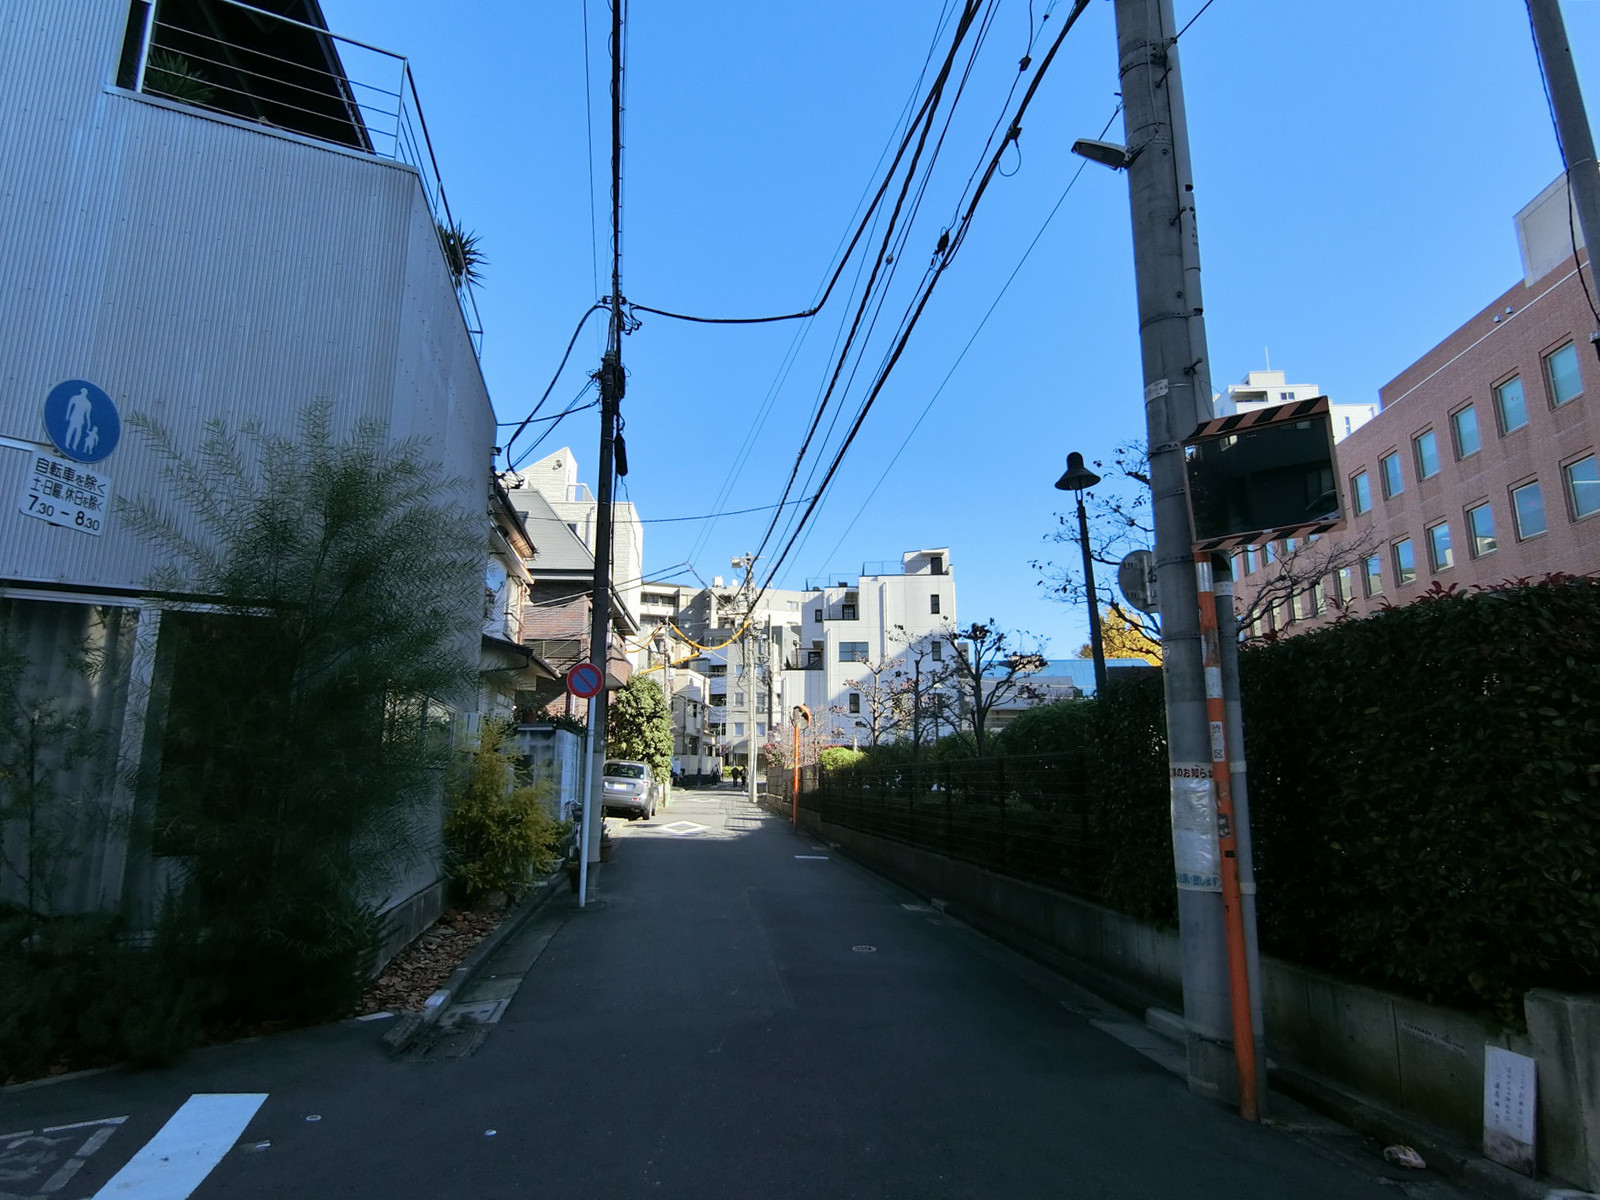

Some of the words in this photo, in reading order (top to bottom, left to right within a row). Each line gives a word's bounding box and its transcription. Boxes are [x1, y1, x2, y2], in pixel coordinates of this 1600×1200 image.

[36, 457, 107, 495] 自転車を除く
